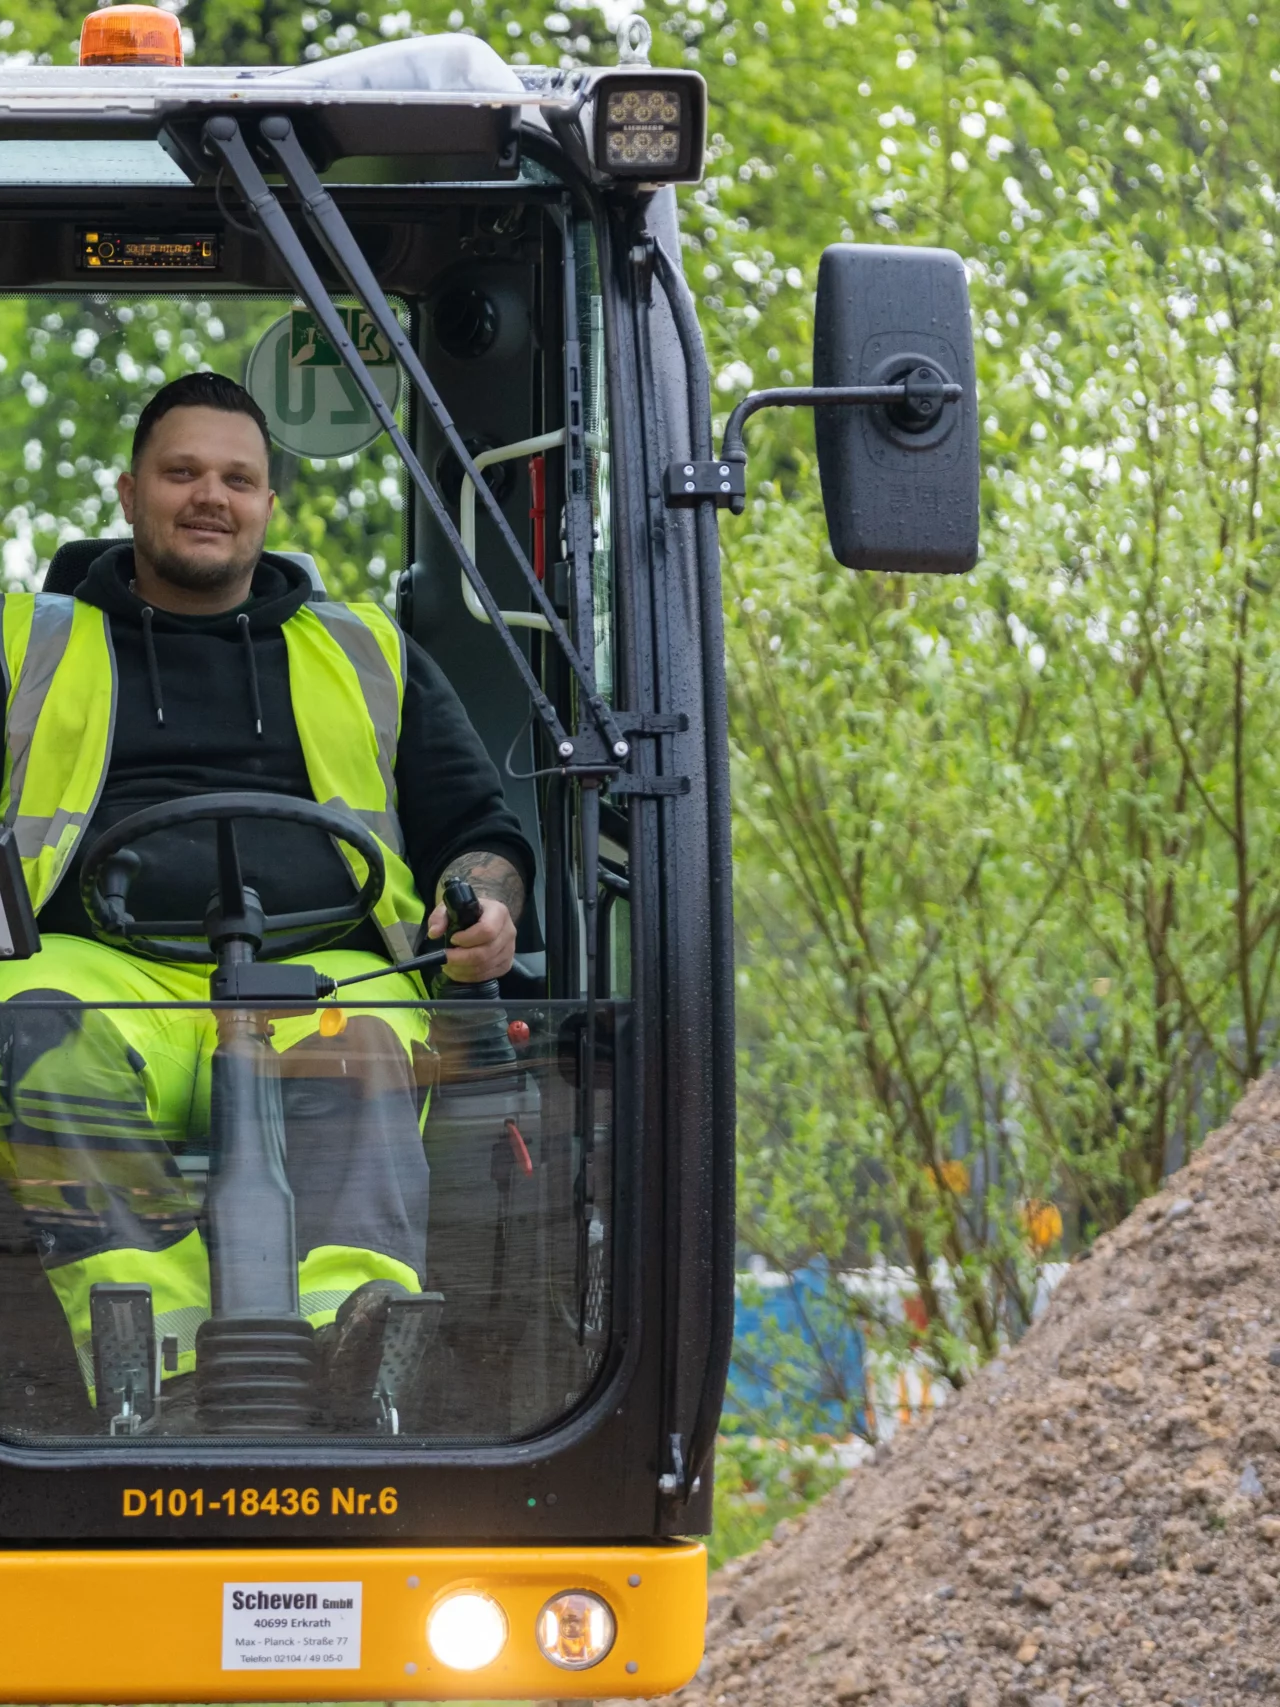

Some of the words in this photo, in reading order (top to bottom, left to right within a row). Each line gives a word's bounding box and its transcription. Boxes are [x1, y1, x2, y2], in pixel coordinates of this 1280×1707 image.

[122, 1488, 320, 1517] D101-18436
[331, 1487, 398, 1515] Nr.6
[232, 1590, 318, 1610] Scheven
[322, 1598, 354, 1609] GmbH
[254, 1618, 288, 1628] 40699
[291, 1617, 331, 1628] Erkrath
[235, 1638, 256, 1646] Max
[264, 1637, 295, 1646] Planck
[303, 1636, 334, 1646] Straße
[336, 1637, 349, 1645] 77
[240, 1654, 272, 1663] Telefon
[274, 1654, 302, 1663] 02104
[309, 1654, 321, 1663] 49
[323, 1654, 343, 1662] 05-0
